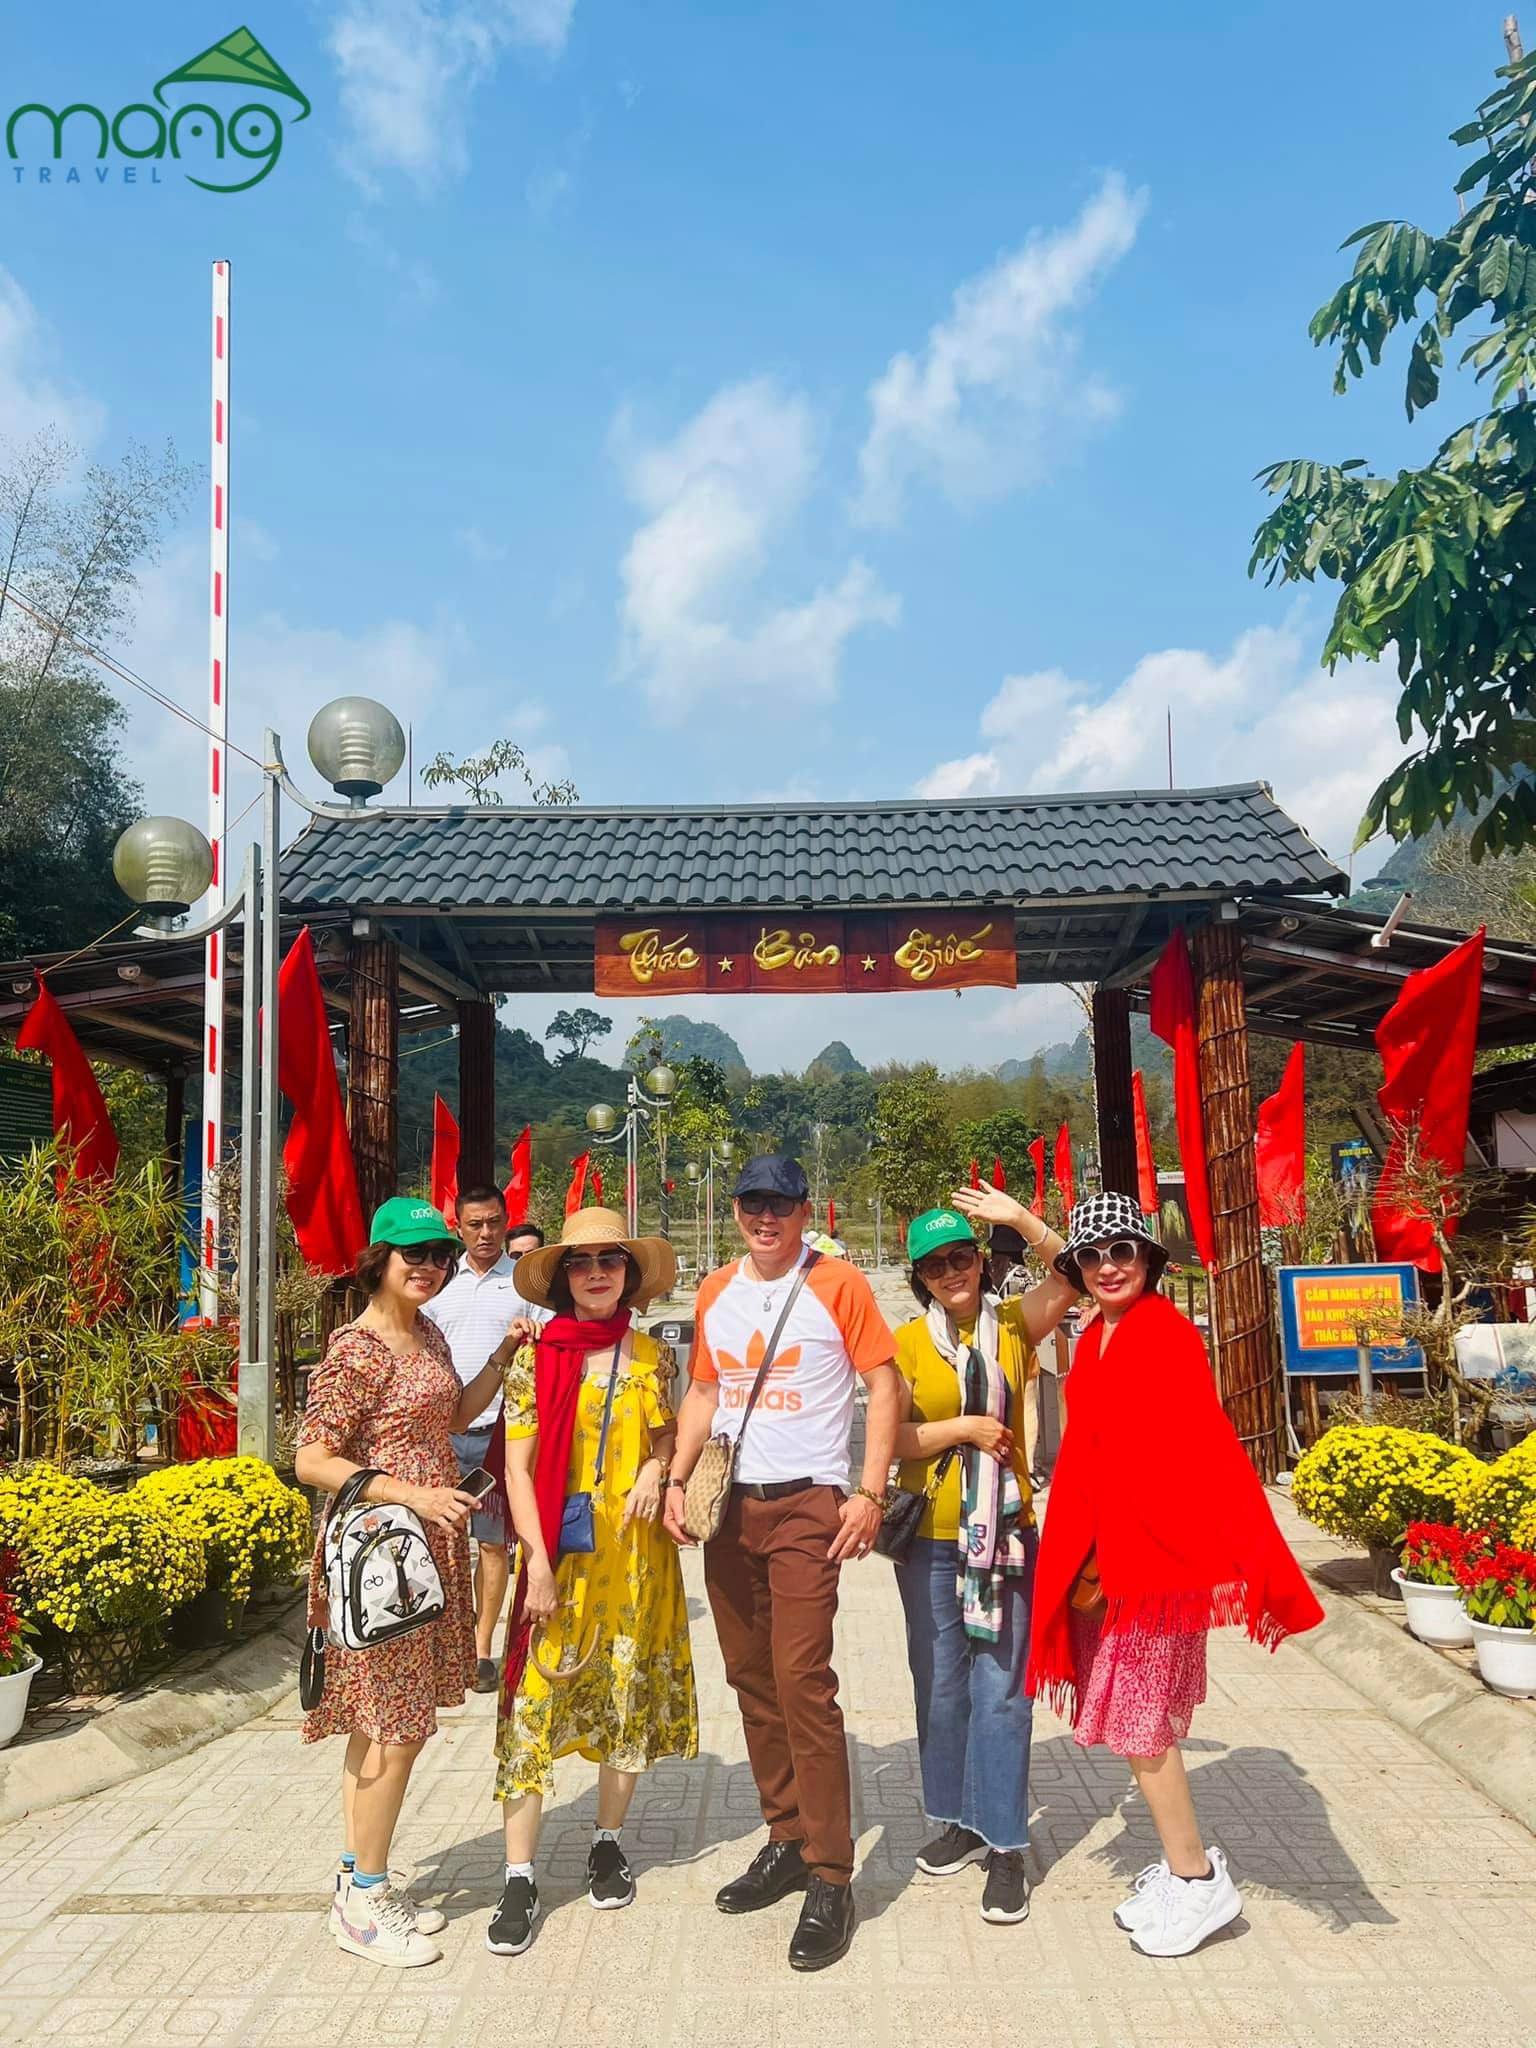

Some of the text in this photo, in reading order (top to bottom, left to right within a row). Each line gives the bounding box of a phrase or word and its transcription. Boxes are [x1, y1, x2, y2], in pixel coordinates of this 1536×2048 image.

[619, 922, 993, 984] Thác Bản Giốc
[1313, 1327, 1340, 1343] THÁC
